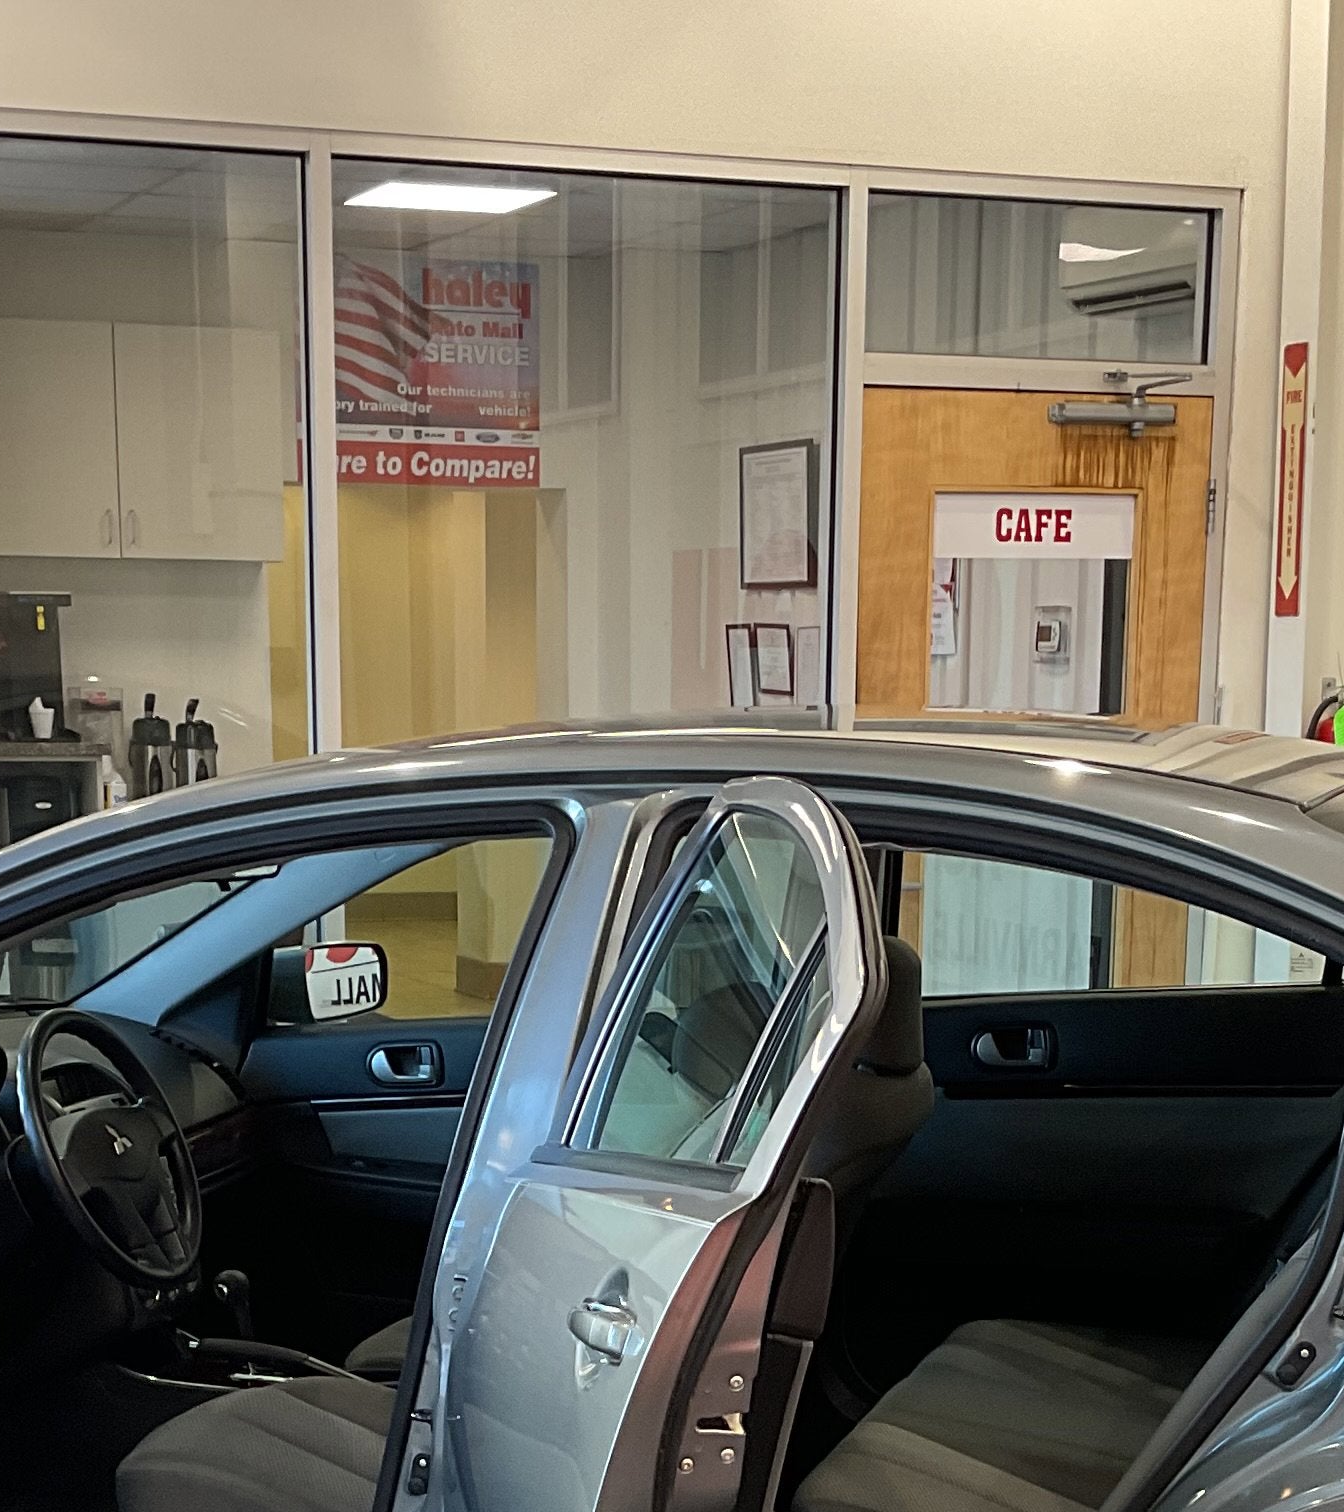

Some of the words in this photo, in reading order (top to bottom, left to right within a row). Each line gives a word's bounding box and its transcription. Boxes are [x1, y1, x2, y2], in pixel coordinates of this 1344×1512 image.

[422, 268, 531, 319] haley
[482, 322, 523, 339] Mall
[423, 342, 530, 366] SERVICE
[397, 383, 422, 395] Our
[427, 385, 504, 399] technicians
[510, 389, 531, 400] are
[1286, 390, 1302, 404] FIRE
[359, 399, 408, 413] trained
[412, 402, 432, 414] for
[376, 451, 402, 476] to
[411, 451, 536, 483] Compare!
[994, 507, 1073, 544] CAFE
